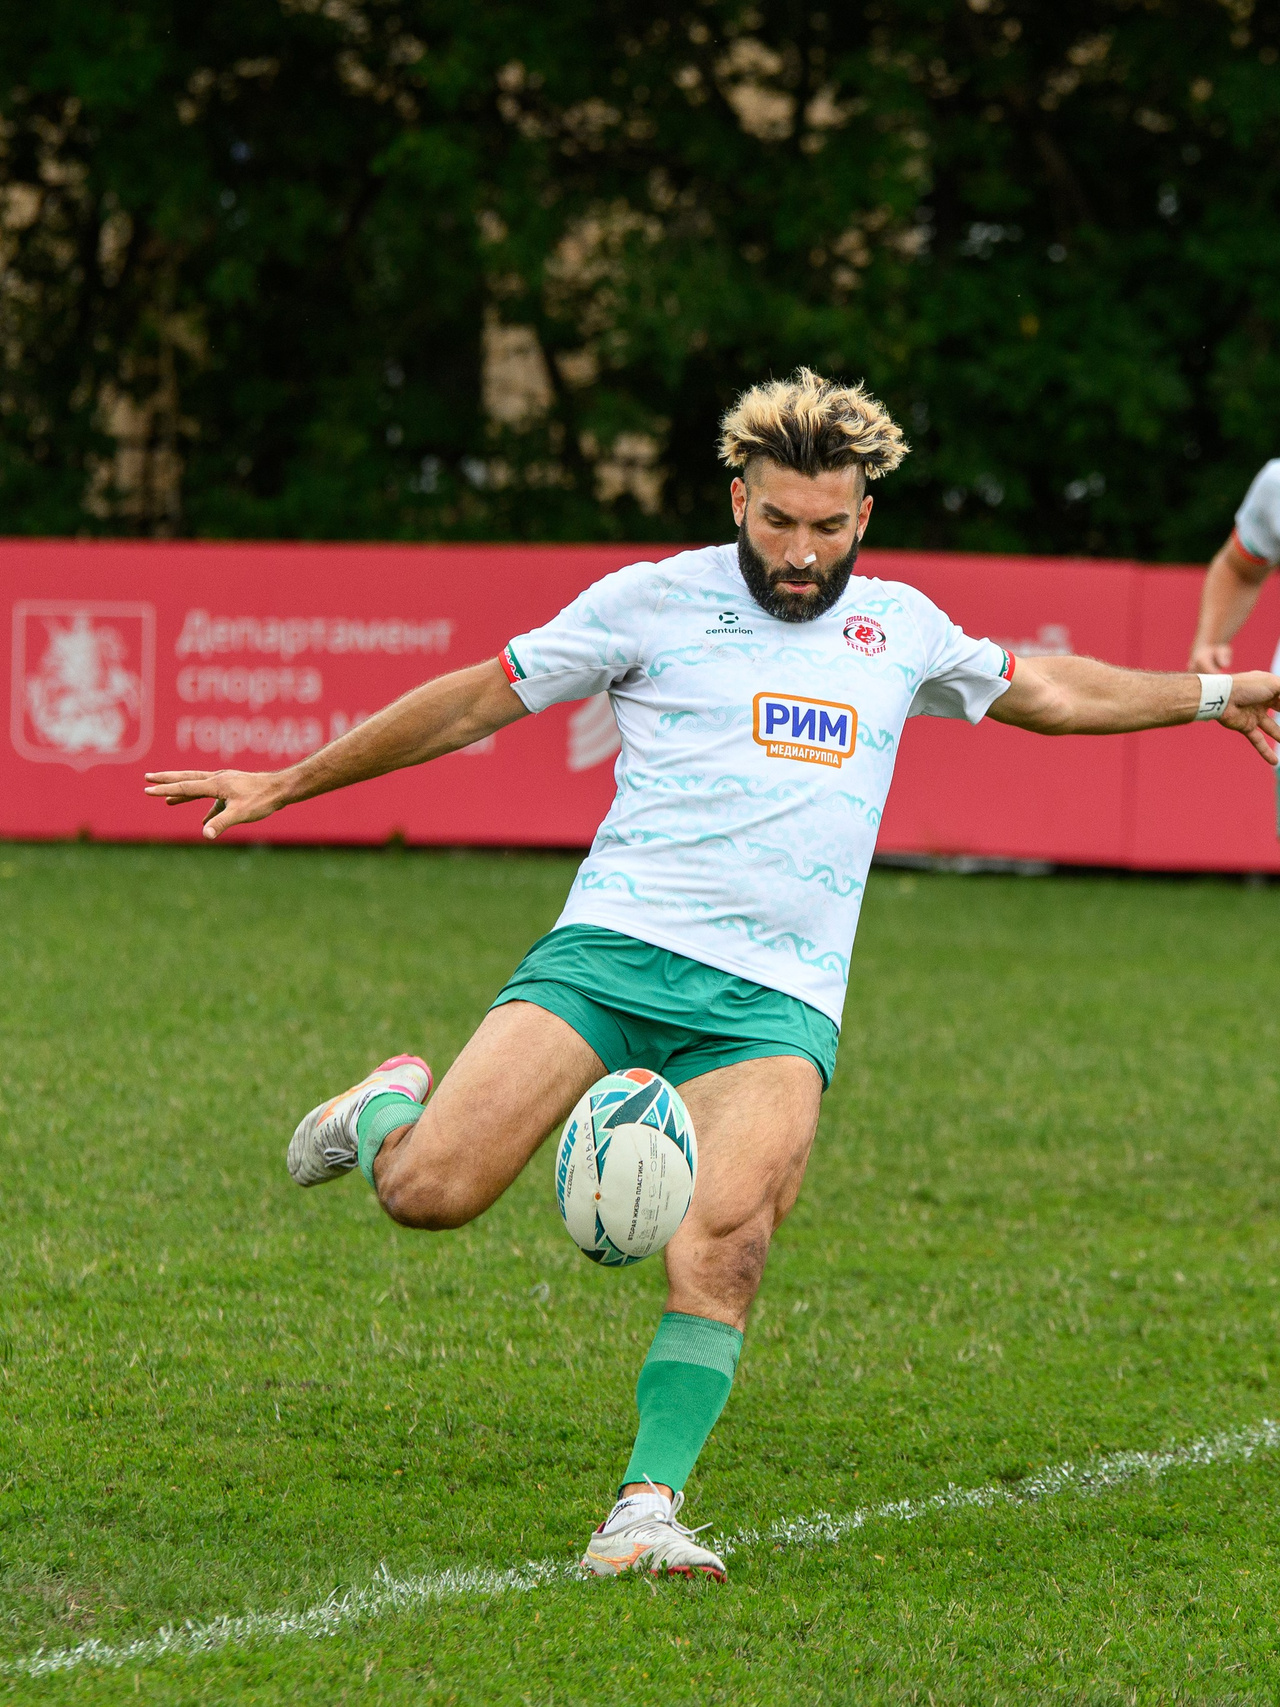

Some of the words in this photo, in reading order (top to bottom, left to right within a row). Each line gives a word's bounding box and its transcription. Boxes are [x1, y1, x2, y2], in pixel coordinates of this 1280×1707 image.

[176, 609, 452, 659] Департамент
[705, 626, 753, 635] centurion
[178, 667, 322, 709] спорта
[177, 716, 322, 760] города
[765, 702, 848, 746] РИМ
[770, 743, 839, 765] МЕДИАГРУППА
[636, 1160, 644, 1196] ПЛАСТИКА
[633, 1196, 641, 1219] ЖИЗНЬ
[628, 1219, 637, 1241] ВТОРАЯ
